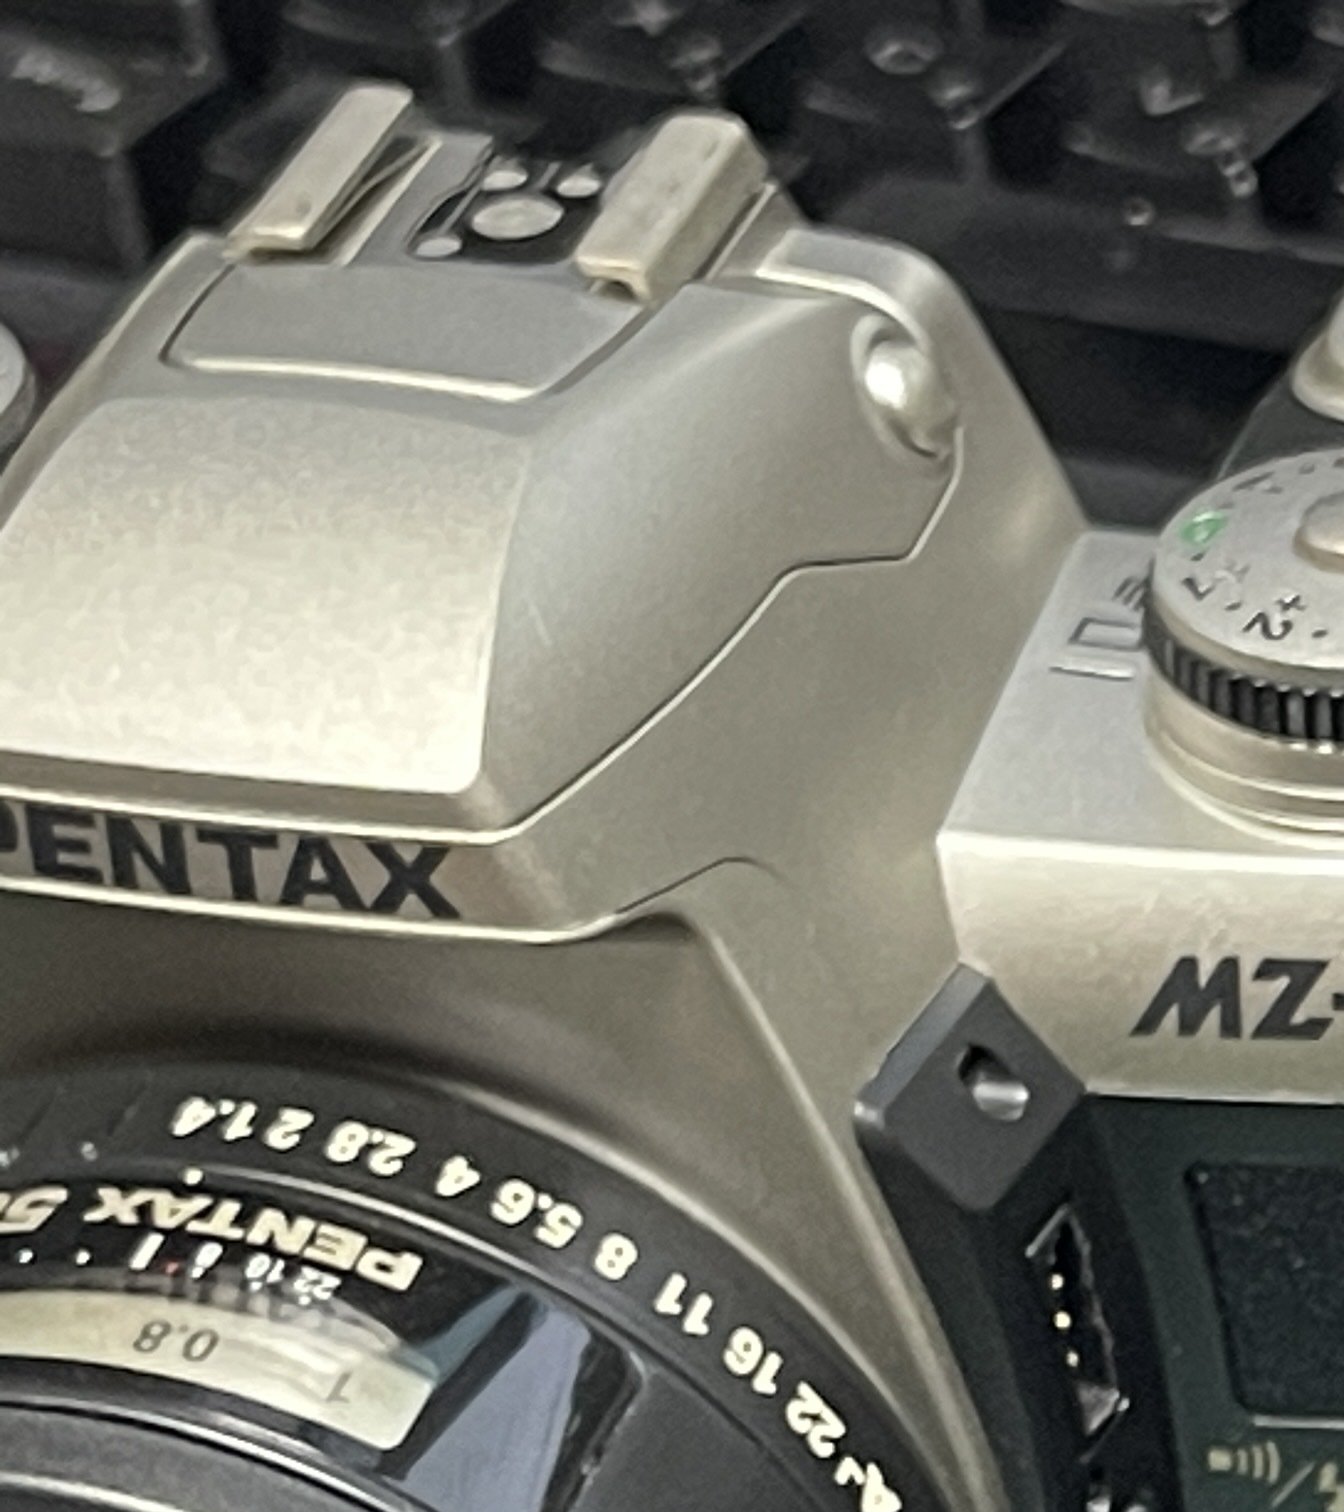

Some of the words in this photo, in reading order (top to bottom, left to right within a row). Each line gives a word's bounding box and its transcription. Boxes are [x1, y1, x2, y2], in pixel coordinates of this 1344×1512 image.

[170, 1096, 258, 1141] 1.4
[263, 1105, 315, 1151] 2
[324, 1121, 417, 1178] 2.8
[434, 1153, 482, 1199] 4
[83, 1186, 424, 1294] PENTAX
[489, 1177, 585, 1251] 5.6
[594, 1233, 640, 1280] 8
[652, 1271, 716, 1335] 11
[132, 1319, 220, 1363] 0.8
[721, 1326, 785, 1396] 16
[785, 1381, 847, 1459] 22
